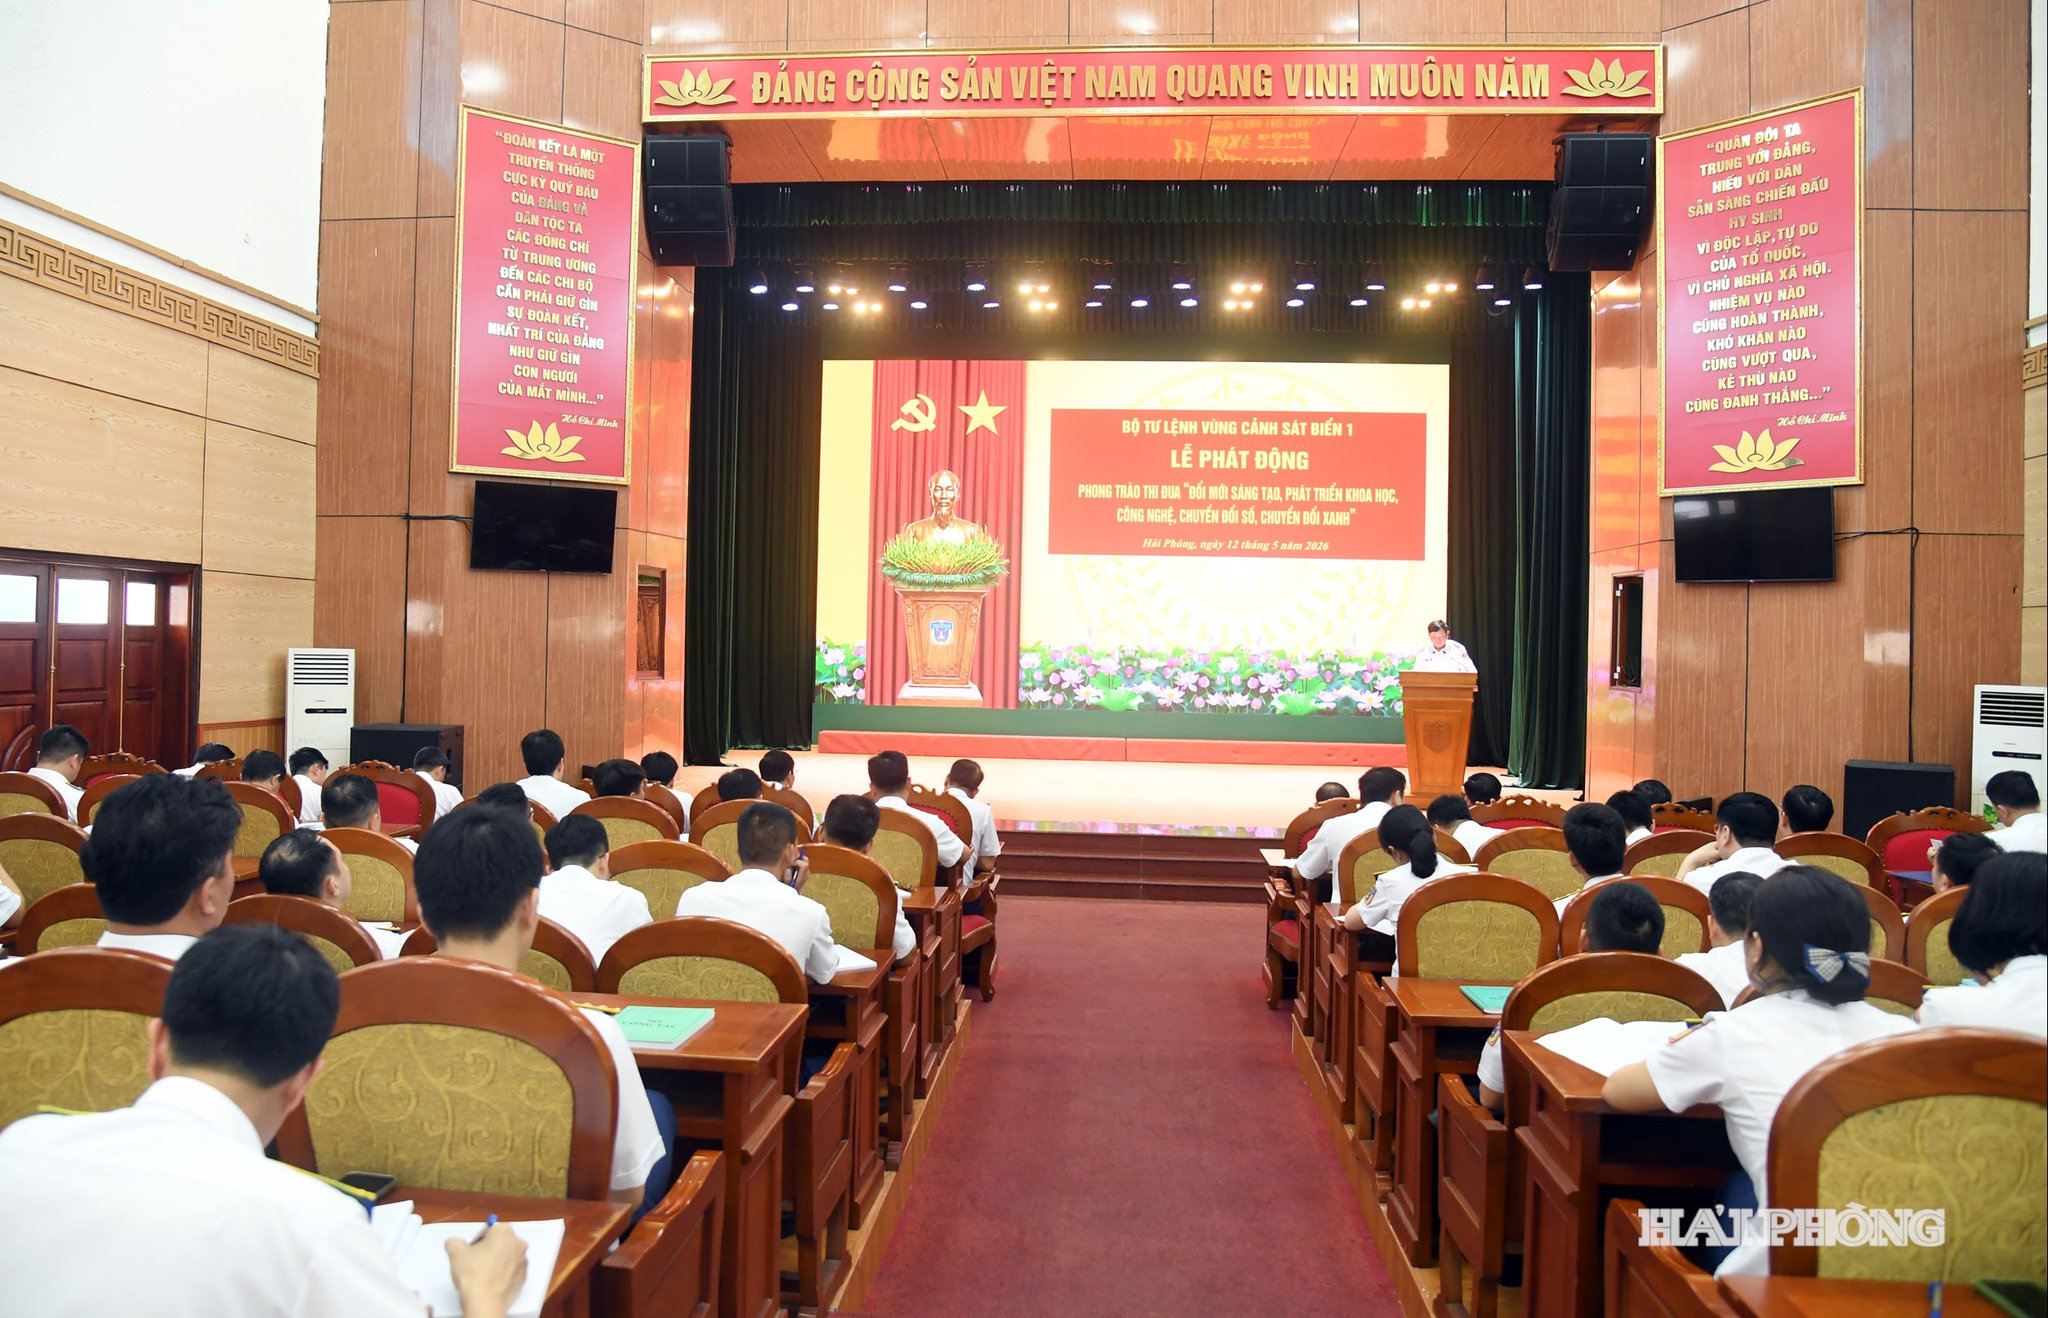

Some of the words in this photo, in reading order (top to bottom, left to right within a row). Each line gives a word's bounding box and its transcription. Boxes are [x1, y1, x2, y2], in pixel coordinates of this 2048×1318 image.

[751, 61, 836, 105] ĐẢNG
[845, 60, 930, 109] CỘNG
[940, 55, 1003, 101] SẢN
[1009, 58, 1075, 106] VIỆT
[1085, 64, 1158, 100] NAM
[1166, 63, 1273, 103] QUANG
[1283, 63, 1359, 98] VINH
[1370, 56, 1465, 99] MUÔN
[1475, 56, 1550, 98] NĂM
[1755, 126, 1778, 145] ĐỘI
[1783, 122, 1801, 137] TA
[538, 138, 561, 154] KẾT
[563, 144, 577, 158] LÀ
[581, 149, 605, 164] MỘT
[1700, 158, 1742, 177] TRUNG
[1747, 148, 1769, 166] VỚI
[1773, 141, 1815, 160] ĐẢNG,
[508, 153, 554, 172] TRUYỀN
[557, 162, 595, 180] THỐNG
[1712, 175, 1742, 194] HIẾU
[1747, 168, 1769, 186] VỚI
[1775, 163, 1802, 181] DÂN
[503, 171, 527, 186] CỰC
[531, 175, 547, 189] KỲ
[550, 177, 573, 194] QUÝ
[576, 183, 598, 199] BÁU
[1717, 194, 1751, 213] SÀNG
[1756, 182, 1796, 204] CHIẾN
[1801, 175, 1829, 195] ĐẤU
[511, 190, 534, 206] CỦA
[538, 195, 570, 213] ĐẢNG
[573, 202, 588, 216] VÀ
[515, 211, 539, 226] DÂN
[542, 216, 564, 232] TỘC
[568, 221, 582, 234] TA
[1729, 215, 1746, 230] HY
[1752, 208, 1783, 225] SINH
[506, 228, 530, 243] CÁC
[569, 240, 590, 254] CHÍ
[1697, 239, 1710, 255] VÌ
[1714, 235, 1741, 254] ĐỘC
[1800, 222, 1819, 235] DO
[502, 246, 518, 261] TỪ
[523, 251, 561, 268] TRUNG
[566, 258, 596, 274] ƯƠNG
[1710, 254, 1737, 272] CỦA
[1741, 247, 1759, 267] TỔ
[1764, 242, 1806, 263] QUỐC,
[500, 265, 524, 281] ĐẾN
[527, 269, 550, 285] CÁC
[554, 277, 574, 289] CHI
[577, 278, 593, 295] BỘ
[1688, 280, 1701, 296] VÌ
[1704, 275, 1730, 293] CHỦ
[1734, 271, 1774, 289] NGHĨA
[1779, 266, 1797, 281] XÃ
[524, 289, 552, 305] PHẢI
[556, 293, 575, 308] GIỮ
[579, 297, 598, 312] GÌN
[1709, 294, 1750, 313] NHIỆM
[1754, 291, 1773, 307] VỤ
[1778, 284, 1806, 301] NÀO
[507, 306, 523, 322] SỰ
[527, 310, 559, 325] ĐOÀN
[563, 312, 588, 331] KẾT,
[1693, 317, 1727, 334] CŨNG
[1731, 310, 1767, 328] HOÀN
[1772, 304, 1824, 323] THÀNH,
[488, 322, 519, 338] NHẤT
[524, 326, 543, 341] TRÍ
[547, 329, 570, 344] CỦA
[573, 333, 604, 350] ĐẢNG
[1707, 335, 1733, 352] KHÓ
[1778, 326, 1806, 343] NÀO
[509, 345, 535, 359] NHƯ
[537, 348, 557, 362] GIỮ
[561, 351, 580, 365] GÌN
[1703, 356, 1736, 373] CŨNG
[1742, 350, 1777, 368] VƯỢT
[1783, 346, 1817, 363] QUA,
[514, 364, 538, 379] CON
[1718, 373, 1735, 390] KẺ
[1739, 371, 1765, 388] THÙ
[1769, 368, 1797, 384] NÀO
[498, 380, 522, 396] CỦA
[527, 383, 552, 399] MẮT
[1686, 396, 1718, 413] CŨNG
[1723, 391, 1759, 410] ĐÁNH
[1122, 419, 1140, 440] BỘ
[1143, 419, 1161, 434] TƯ
[1164, 419, 1197, 439] LỆNH
[1202, 419, 1238, 435] VÙNG
[1241, 417, 1278, 435] CẢNH
[1282, 419, 1308, 436] SÁT
[1311, 418, 1342, 436] BIỂN
[1347, 422, 1353, 437] 1
[1171, 443, 1192, 468] LỄ
[1200, 446, 1249, 469] PHÁT
[1255, 448, 1309, 473] ĐỘNG
[1078, 484, 1112, 498] PHONG
[1115, 481, 1140, 499] TRÀO
[1143, 485, 1158, 499] THI
[1161, 485, 1181, 500] ĐUA
[1209, 482, 1228, 500] MỚI
[1231, 483, 1258, 501] SÁNG
[1261, 487, 1282, 503] TẠO,
[1285, 484, 1311, 501] PHÁT
[1314, 482, 1342, 502] TRIỂN
[1346, 488, 1372, 502] KHOA
[1375, 488, 1398, 505] HỌC,
[1117, 506, 1144, 522] CÔNG
[1147, 506, 1176, 526] NGHỆ,
[1179, 505, 1219, 523] CHUYỂN
[1222, 505, 1238, 523] ĐỔI
[1241, 505, 1258, 525] SỐ,
[1261, 506, 1300, 524] CHUYỂN
[1303, 506, 1320, 525] ĐỔI
[1142, 538, 1161, 548] Hải
[1163, 538, 1196, 550] Phòng,
[1200, 540, 1224, 551] ngày
[1227, 540, 1239, 549] 12
[1241, 540, 1269, 551] tháng
[1272, 541, 1279, 549] 5
[1282, 541, 1302, 550] năm
[1305, 541, 1329, 551] 2026
